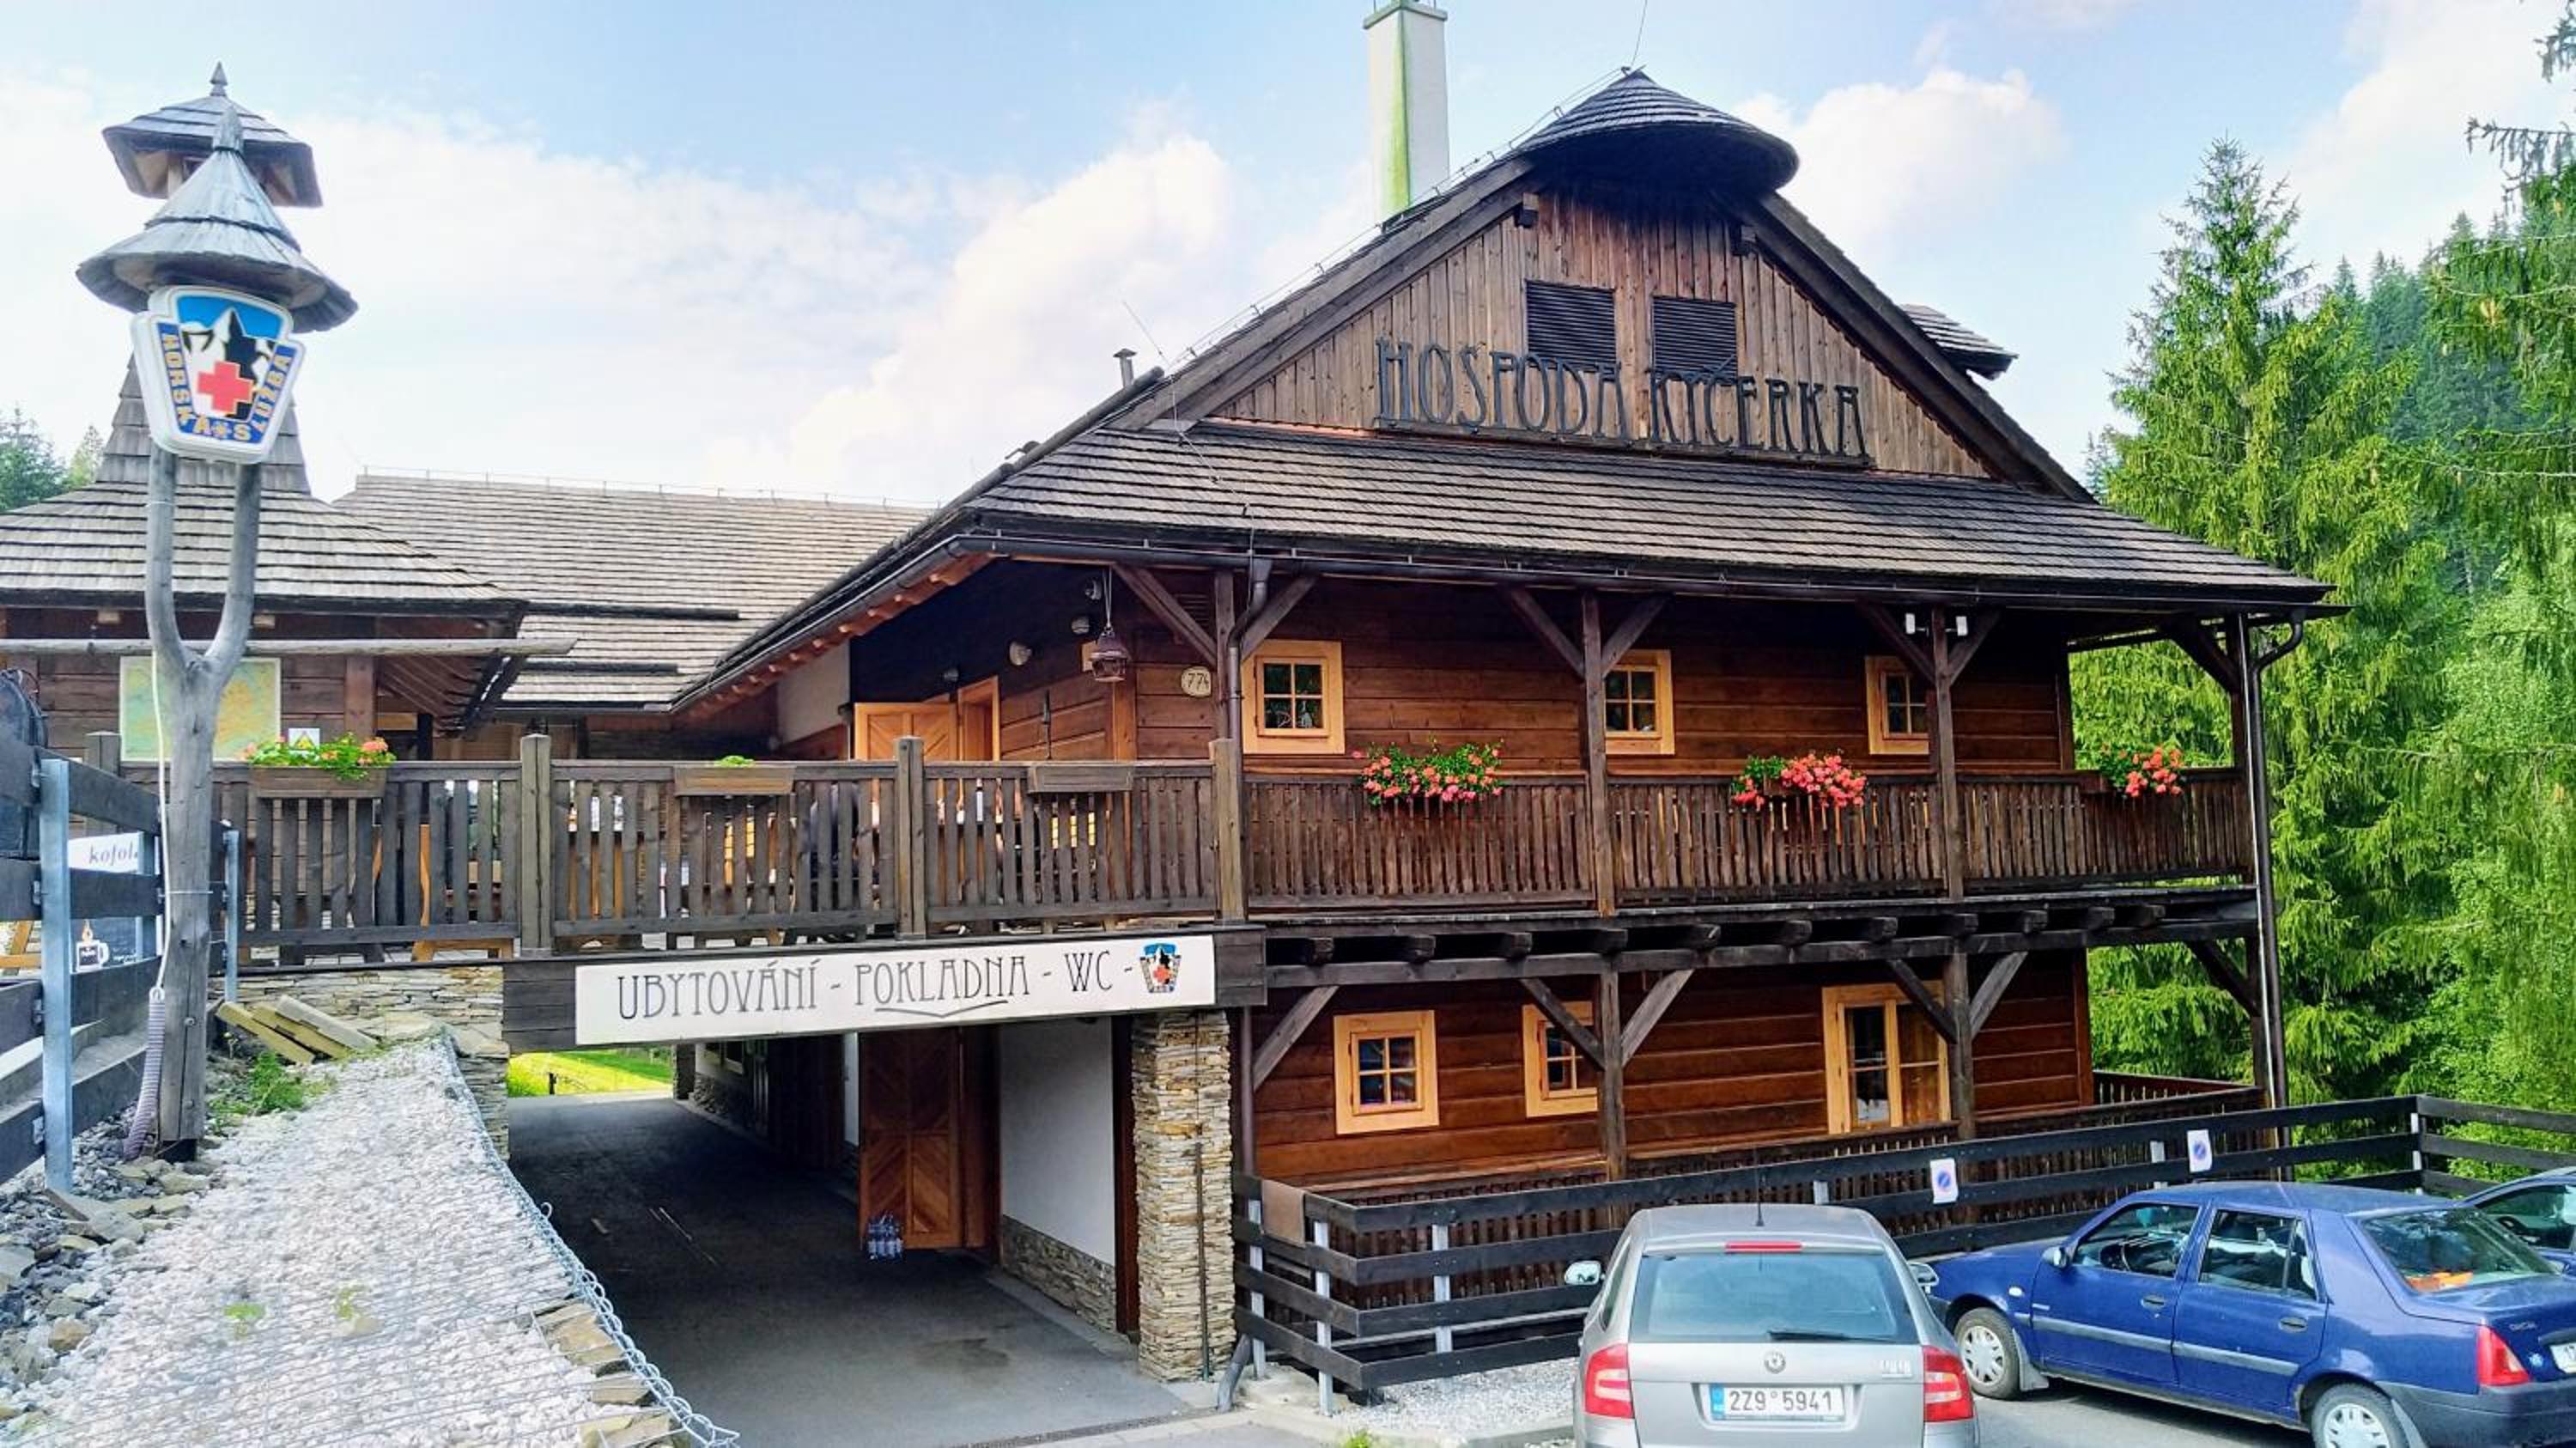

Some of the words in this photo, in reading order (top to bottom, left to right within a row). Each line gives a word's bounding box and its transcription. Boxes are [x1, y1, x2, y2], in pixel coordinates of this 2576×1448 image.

[1376, 338, 1628, 440] HOSPODA
[1646, 354, 1872, 460] KYČERKA
[617, 958, 822, 1020] UBYTOVÁNÍ
[854, 955, 1030, 1006] POKLADNA
[1064, 950, 1114, 992] WC
[1728, 1390, 1766, 1411] 2Z9
[1782, 1389, 1832, 1411] 5941
